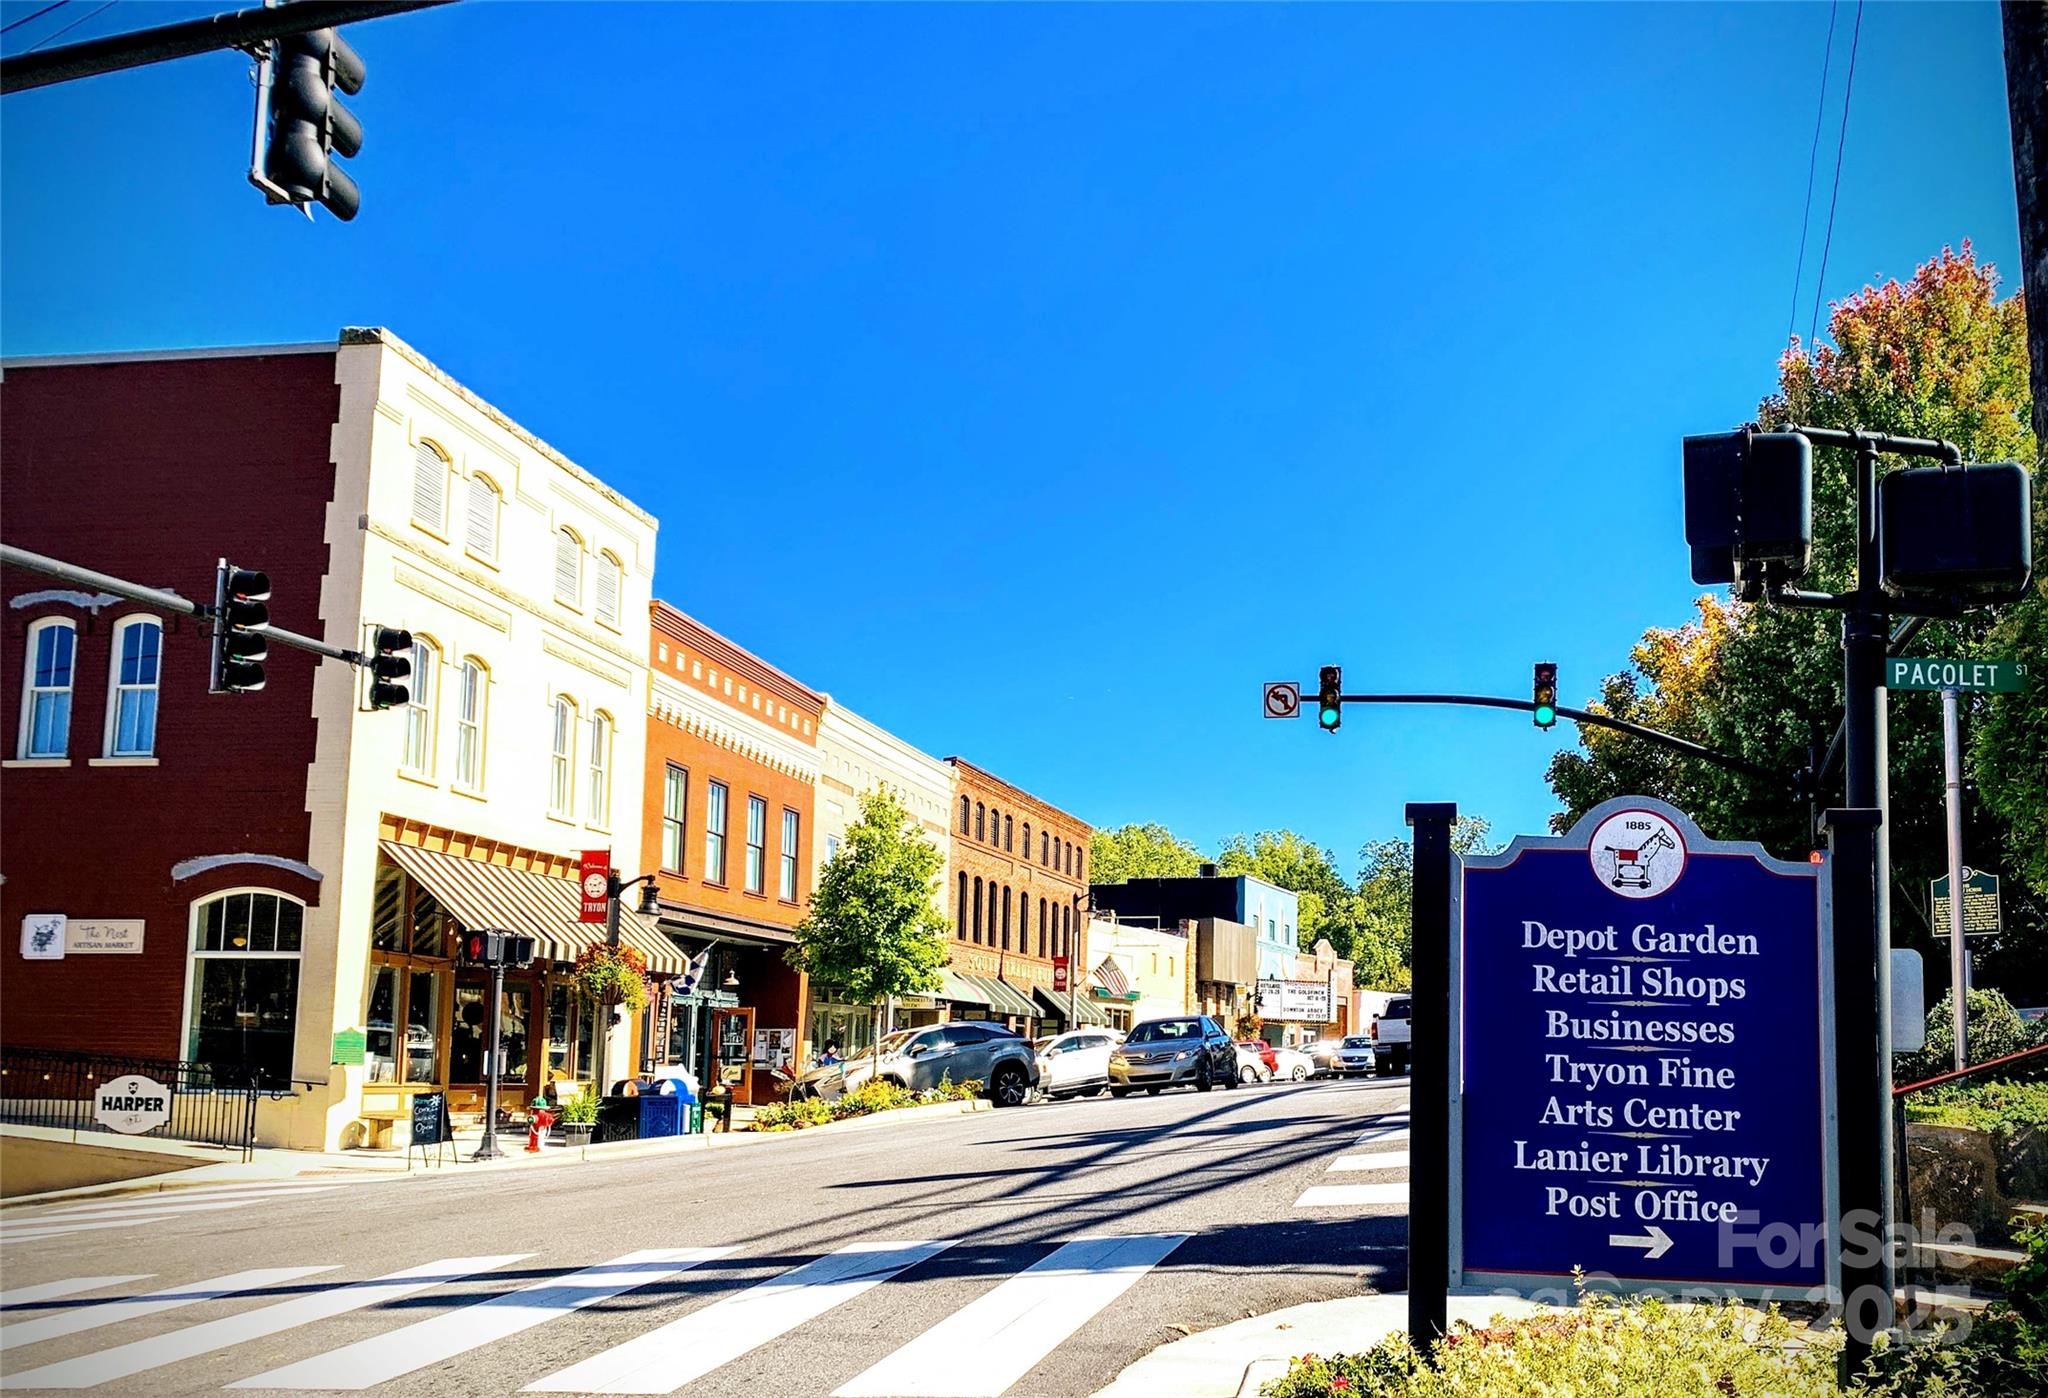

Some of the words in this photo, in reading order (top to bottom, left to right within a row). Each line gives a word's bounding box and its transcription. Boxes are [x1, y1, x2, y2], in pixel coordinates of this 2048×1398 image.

[1894, 663, 1999, 687] PACOLET
[1625, 821, 1652, 831] 1885
[583, 902, 607, 913] TRYON
[79, 925, 101, 940] The
[104, 925, 129, 940] Nest
[1521, 920, 1619, 958] Depot
[1632, 923, 1760, 955] Garden
[1532, 964, 1633, 996] Retail
[1642, 966, 1747, 1006] Shops
[1545, 1009, 1736, 1044] Businesses
[1545, 1053, 1650, 1091] Tryon
[1659, 1056, 1736, 1089] Fine
[102, 1096, 164, 1112] HARPER
[1539, 1096, 1613, 1127] Arts
[1623, 1098, 1741, 1132] Center
[1513, 1140, 1628, 1174] Lanier
[1637, 1144, 1770, 1187] Library
[1545, 1186, 1621, 1219] Post
[1634, 1189, 1738, 1224] Office
